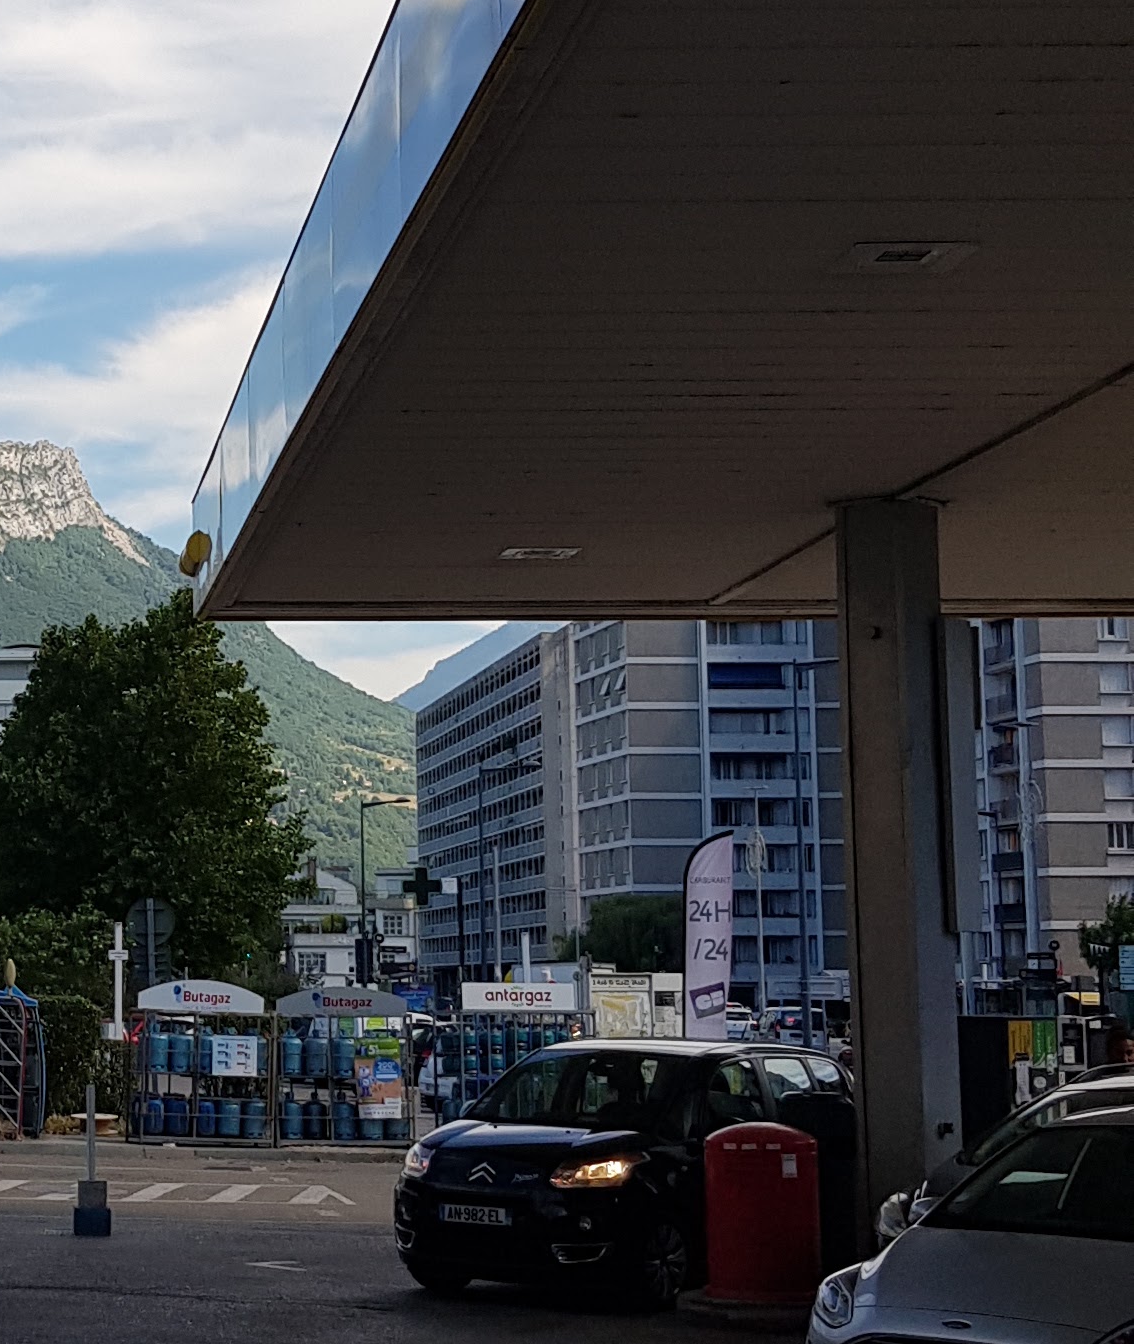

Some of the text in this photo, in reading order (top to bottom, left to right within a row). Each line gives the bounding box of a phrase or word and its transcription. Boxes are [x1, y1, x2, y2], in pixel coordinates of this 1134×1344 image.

[689, 900, 731, 923] 24H
[693, 938, 729, 961] /24
[183, 990, 231, 1006] Butagaz
[322, 996, 373, 1010] Butagaz
[484, 989, 552, 1006] antargaz
[447, 1206, 503, 1224] AN-982-EL
